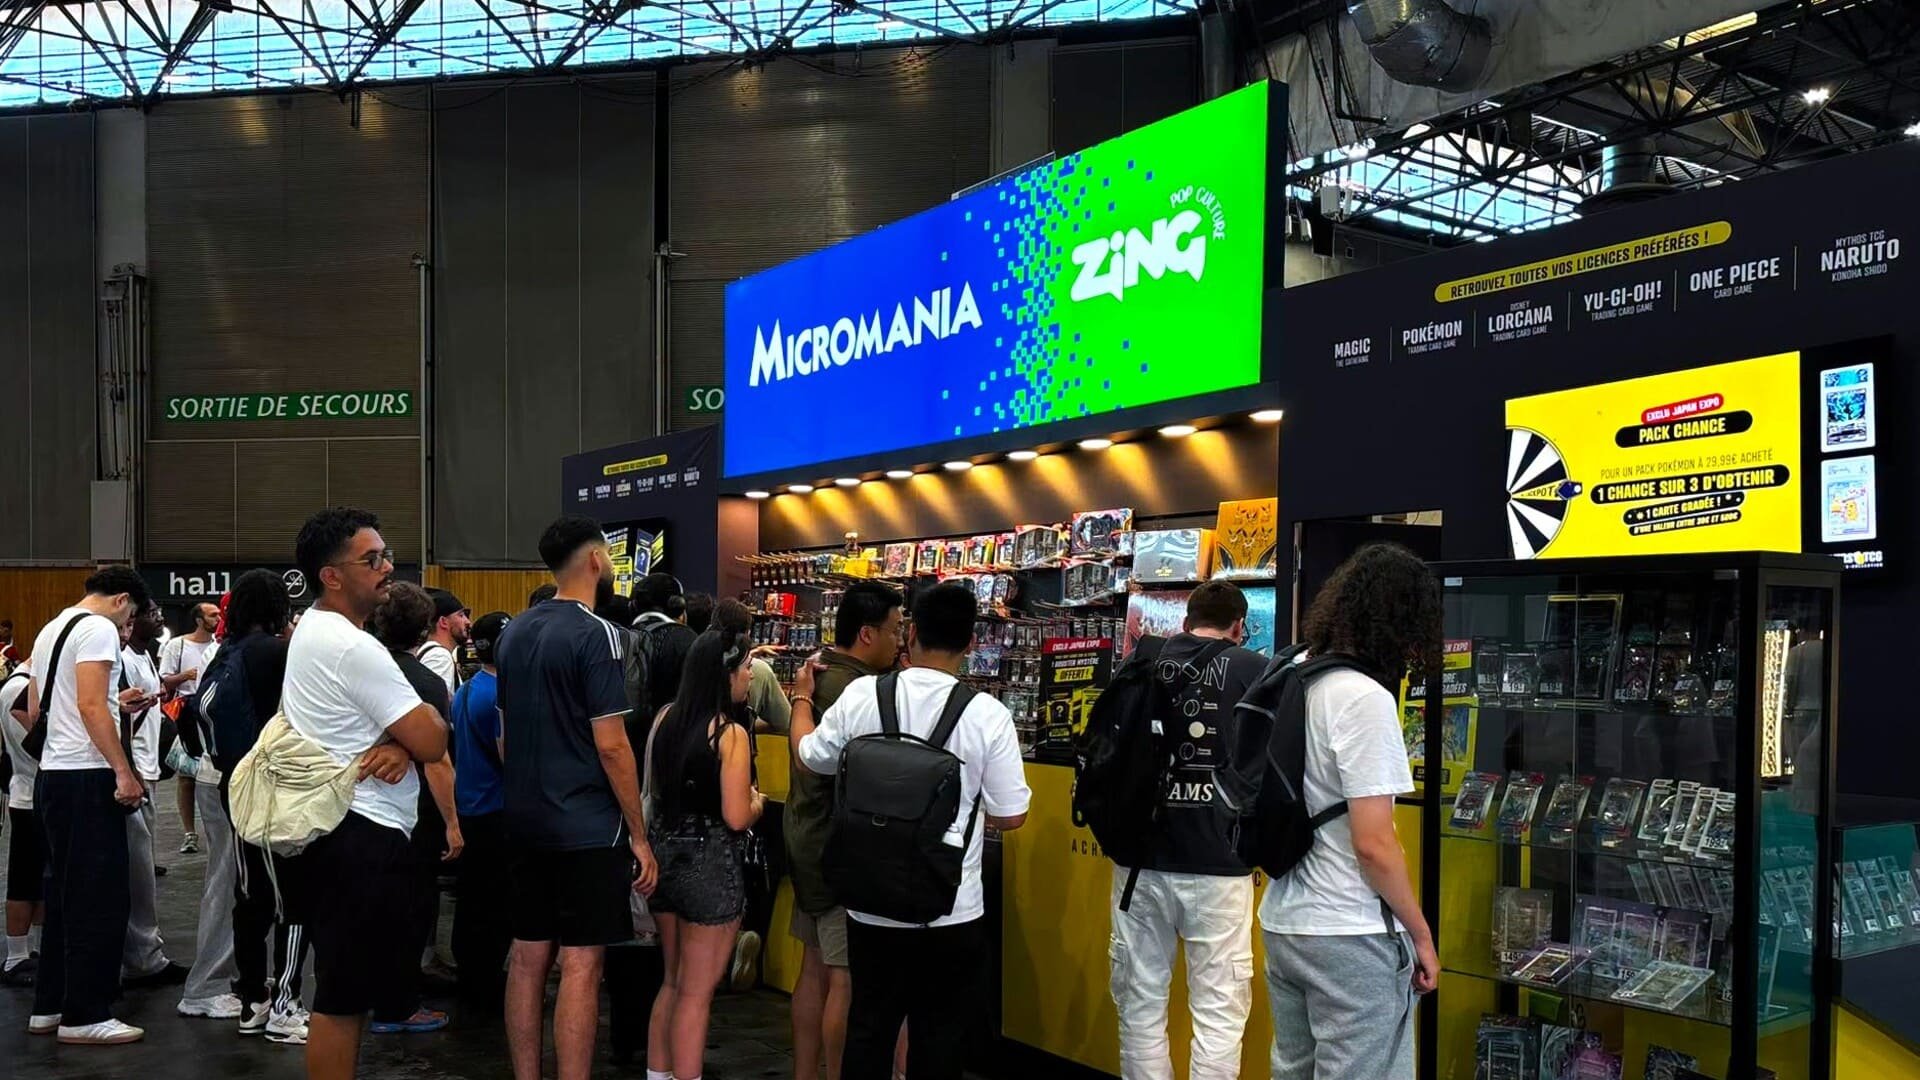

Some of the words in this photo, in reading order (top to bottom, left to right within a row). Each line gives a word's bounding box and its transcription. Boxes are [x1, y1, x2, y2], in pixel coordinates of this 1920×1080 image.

[1170, 185, 1193, 208] POP
[1196, 187, 1226, 241] CULTURE
[1836, 233, 1868, 248] MYTHOS
[1869, 230, 1885, 242] TCG
[1450, 275, 1506, 298] RETROUVEZ
[1509, 269, 1548, 286] TOUTES
[1552, 261, 1573, 275] VOS
[1577, 247, 1630, 271] LICENCES
[1633, 231, 1700, 259] PRÉFÉRÉES
[1821, 238, 1900, 272] NARUTO
[1690, 268, 1723, 293] ONE
[1730, 257, 1780, 283] PIECE
[1831, 267, 1862, 282] KONOHA
[1864, 263, 1888, 278] SHIDO
[1584, 280, 1662, 312] YU-GI-OH!
[1714, 287, 1732, 299] CARD
[1734, 284, 1753, 296] GAME
[1488, 305, 1553, 333] LORCANA
[1591, 309, 1616, 322] TRADING
[1618, 306, 1634, 317] CARD
[1636, 303, 1653, 314] GAME
[749, 280, 983, 387] MICROMANIA
[1402, 319, 1463, 346] POKÉMON
[1492, 331, 1515, 343] TRADING
[1516, 328, 1532, 339] CARD
[1533, 325, 1548, 336] GAME
[1334, 338, 1371, 359] MAGIC
[167, 397, 249, 419] SORTIE
[257, 396, 288, 417] DE
[297, 393, 409, 416] SECOURS
[1672, 403, 1697, 416] JAPAN
[1699, 396, 1719, 410] EXPO
[1639, 427, 1670, 443] PACK
[1673, 417, 1726, 439] CHANCE
[1601, 468, 1620, 480] POUR
[1622, 467, 1633, 477] UN
[1636, 464, 1655, 475] PACK
[1658, 459, 1695, 473] POKÉMON
[1698, 455, 1704, 469] À
[1706, 453, 1737, 468] 29,99€
[1740, 449, 1773, 465] ACHETÉ
[1598, 488, 1604, 501] 1
[1608, 483, 1656, 501] CHANCE
[1659, 481, 1686, 496] SUR
[1690, 478, 1699, 492] 3
[1703, 469, 1775, 490] D'OBTENIR
[1646, 508, 1651, 519] 1
[1652, 503, 1679, 518] CARTE
[1681, 496, 1715, 513] GRADÉE
[169, 572, 230, 595] hall
[1453, 642, 1468, 652] EXPO
